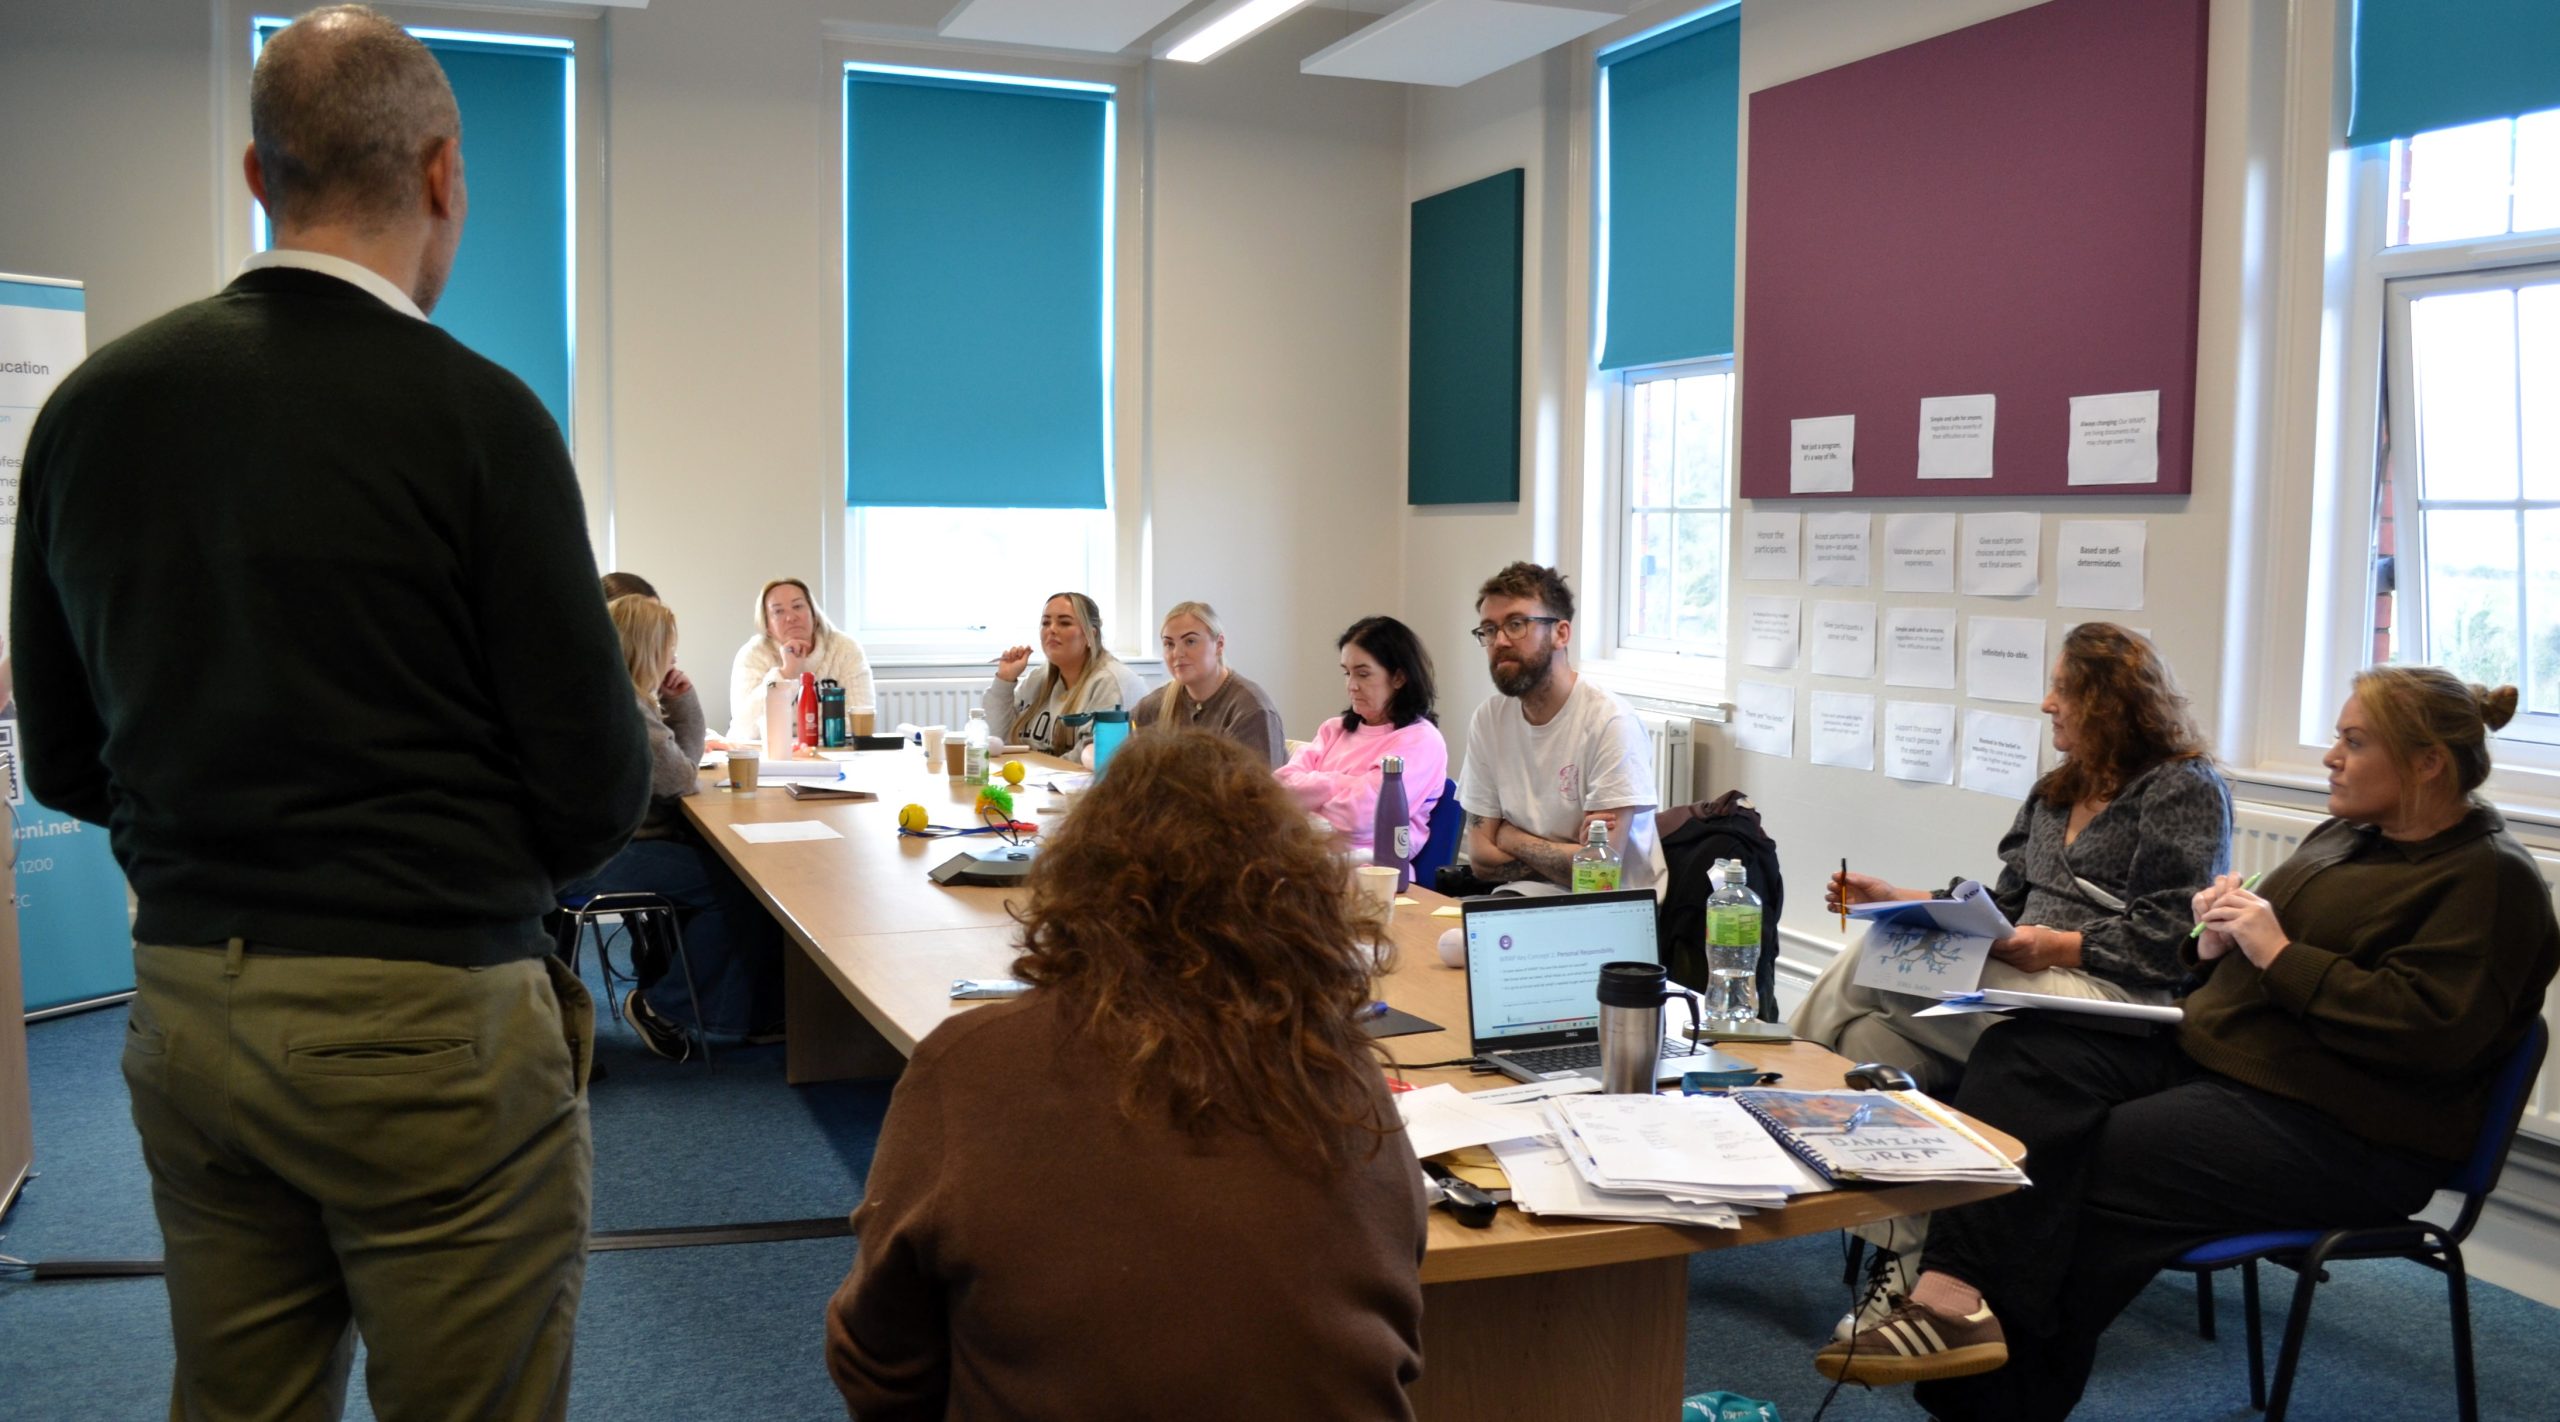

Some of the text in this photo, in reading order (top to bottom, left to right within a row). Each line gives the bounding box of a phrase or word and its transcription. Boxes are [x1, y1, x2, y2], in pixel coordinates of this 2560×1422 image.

[1981, 647, 2029, 660] Infinitely do-able.
[13, 819, 82, 840] cni.net
[20, 857, 54, 874] 1200
[1557, 950, 1579, 958] Personal
